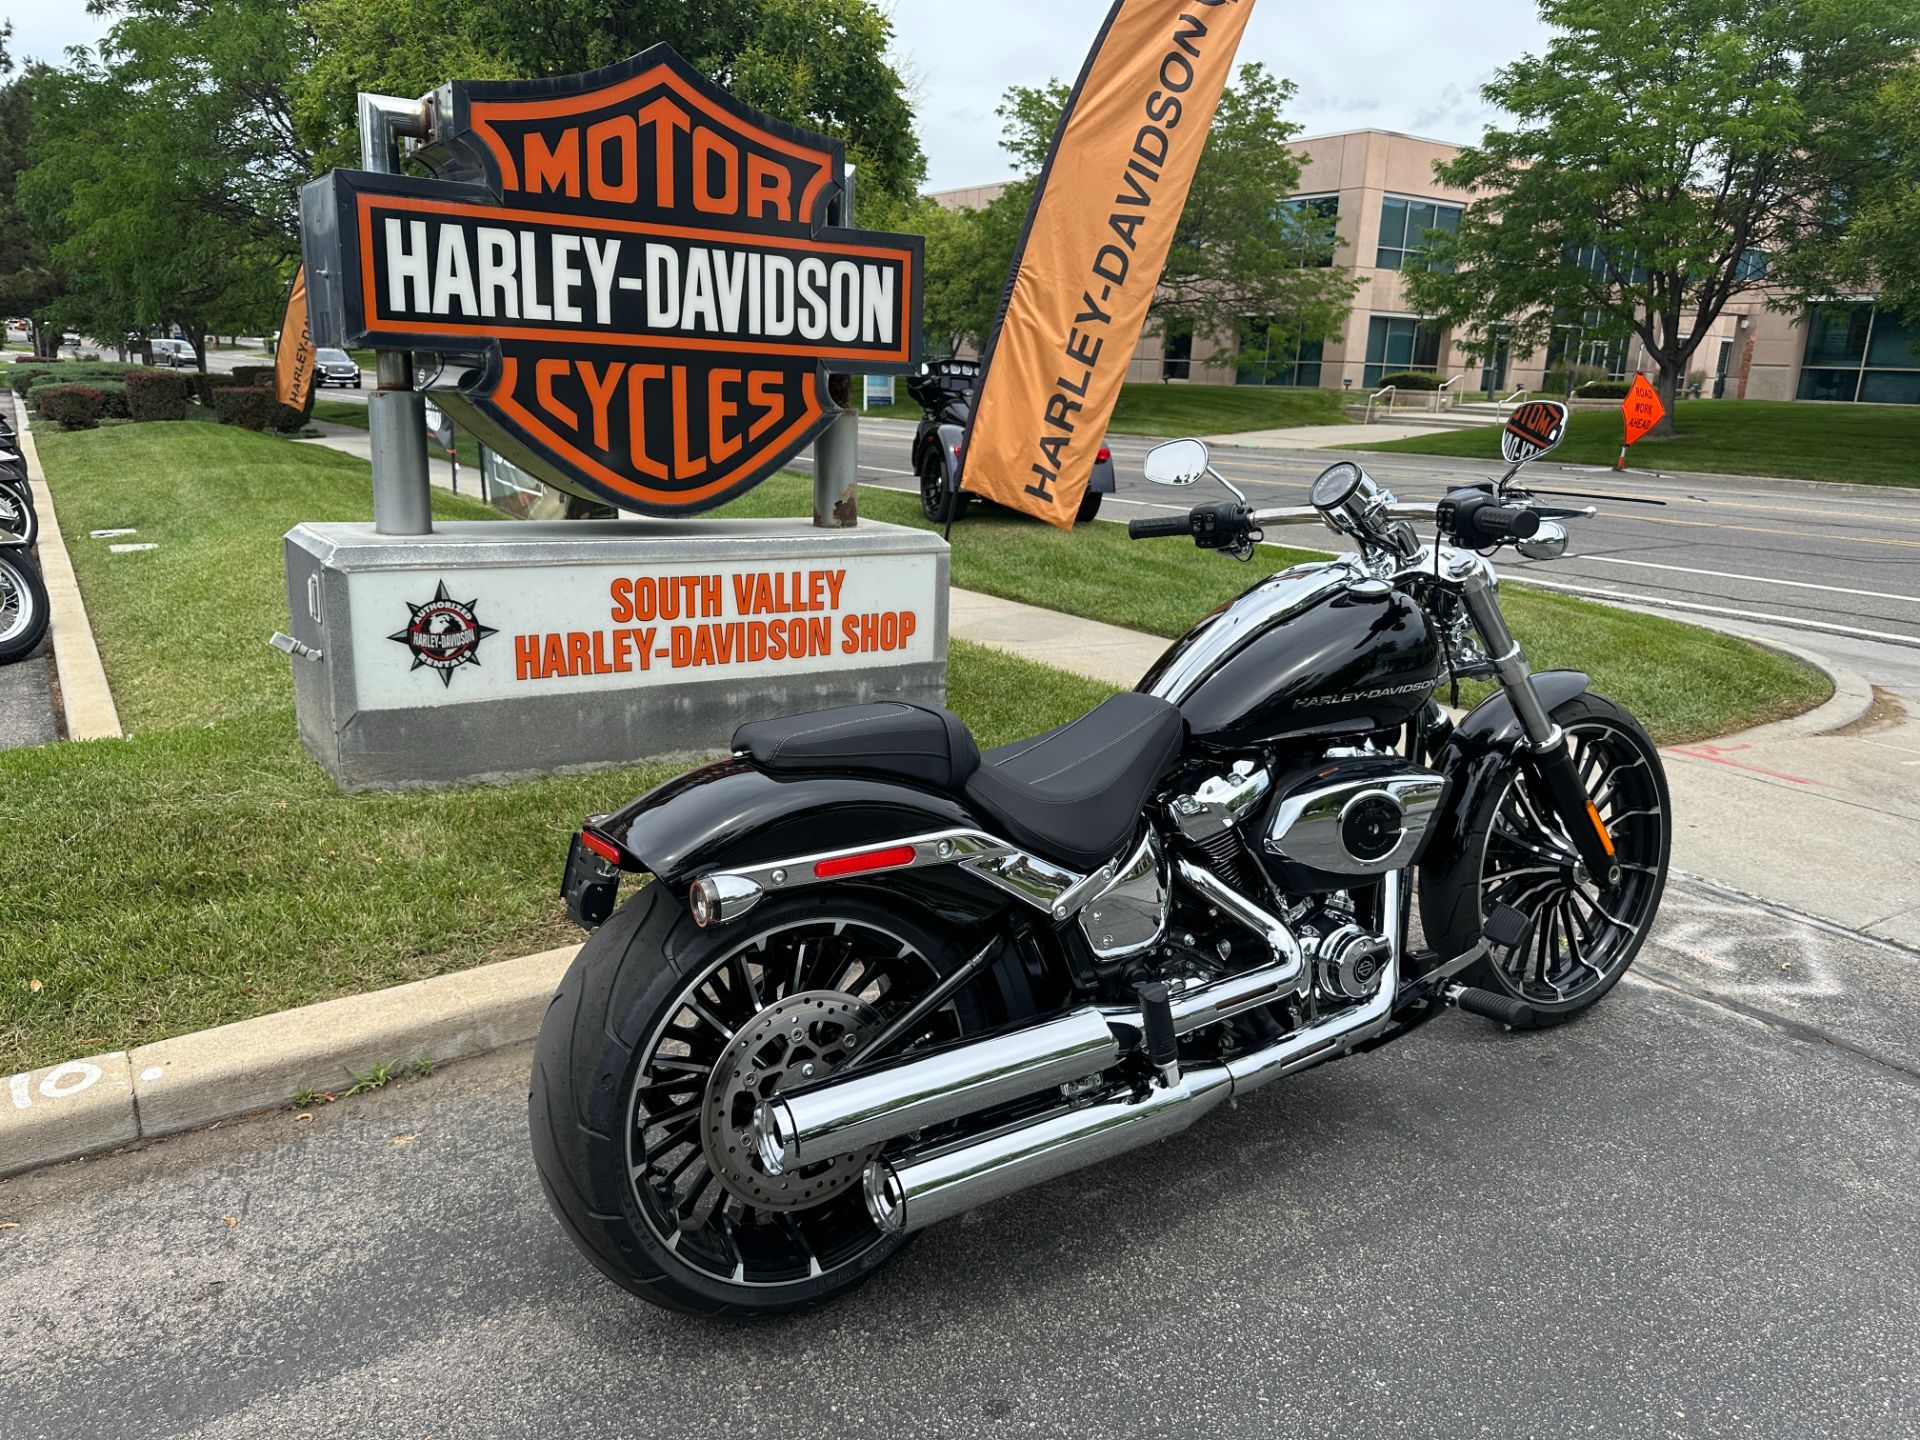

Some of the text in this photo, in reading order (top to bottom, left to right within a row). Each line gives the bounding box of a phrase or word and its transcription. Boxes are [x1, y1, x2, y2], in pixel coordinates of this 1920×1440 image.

[523, 96, 792, 221] MOTOR
[1024, 14, 1208, 503] HARLEY-DAVIDSON
[384, 217, 896, 344] HARLEY-DAVIDSON
[1634, 402, 1653, 414] WORK
[1635, 387, 1653, 399] ROAD
[535, 358, 785, 481] CYCLES
[1628, 418, 1652, 430] AHEAD
[611, 570, 846, 623] SOUTH VALLEY
[413, 601, 473, 624] AUTHORIZED
[413, 629, 475, 648] HARLEY-DAVIDSON
[515, 611, 917, 680] HARLEY-DAVIDSON SHOP
[417, 650, 473, 668] RENTALS
[1292, 679, 1436, 709] HARLEY-DAVIDSON
